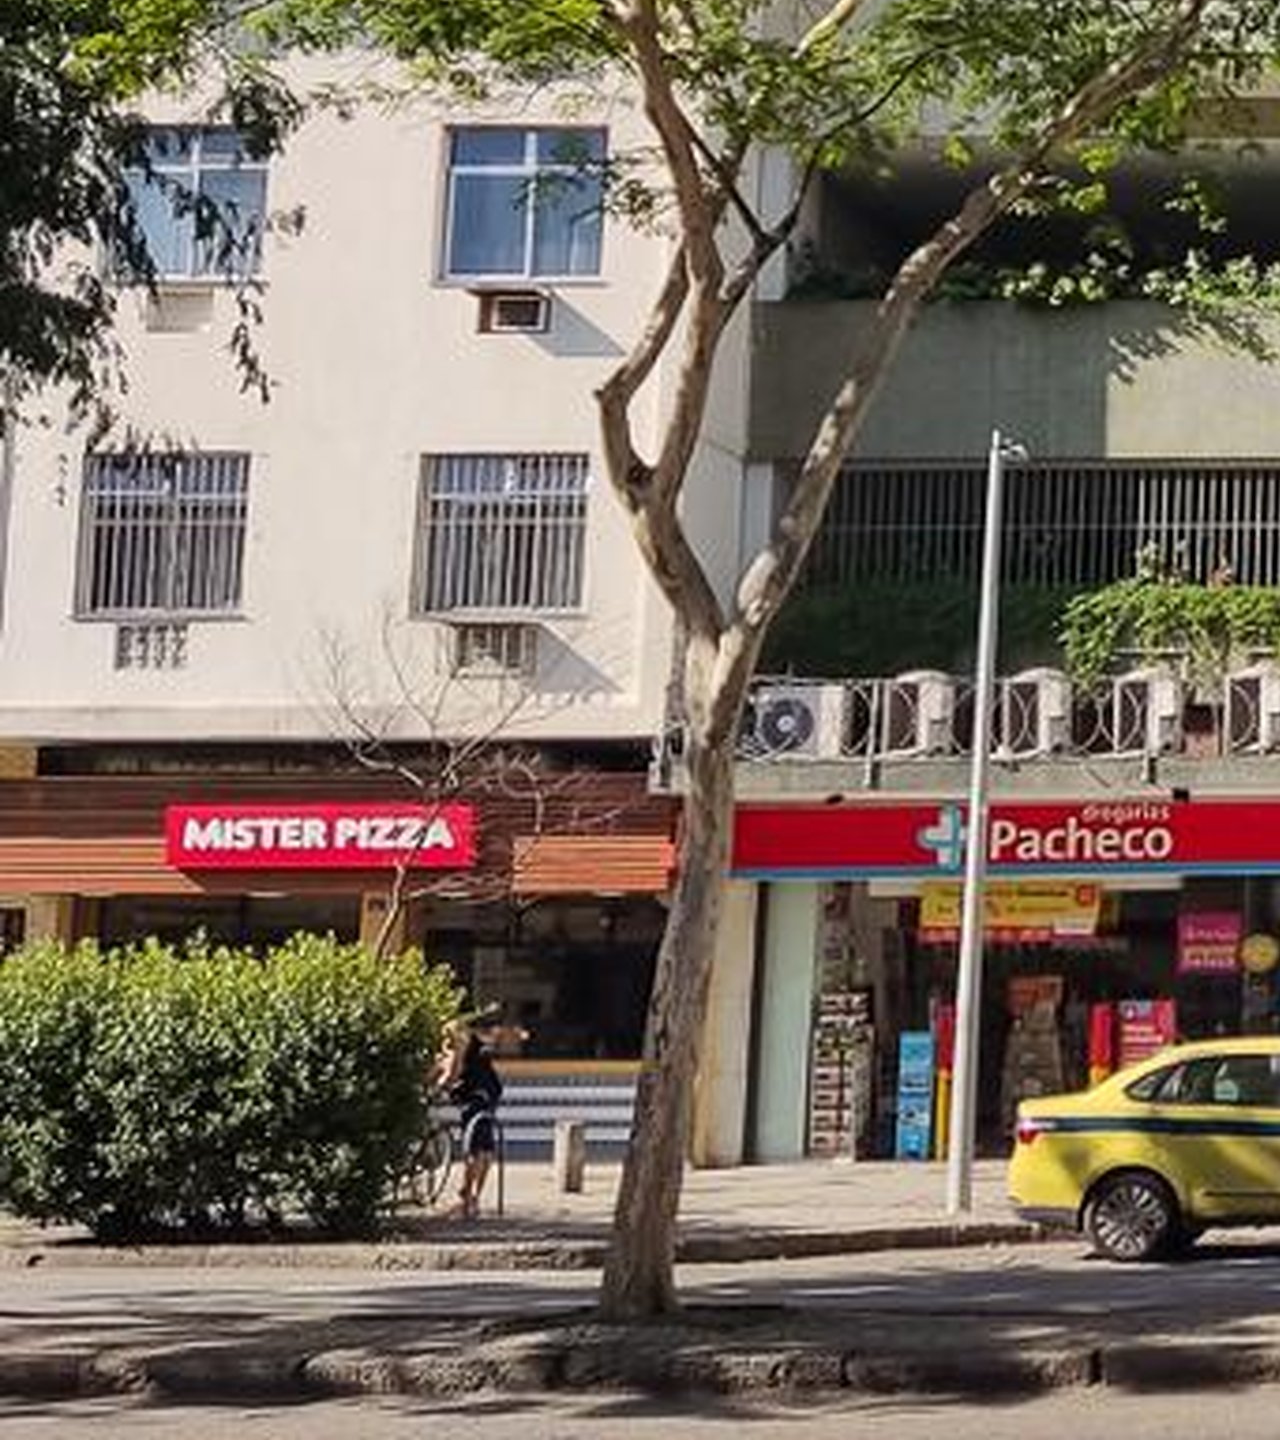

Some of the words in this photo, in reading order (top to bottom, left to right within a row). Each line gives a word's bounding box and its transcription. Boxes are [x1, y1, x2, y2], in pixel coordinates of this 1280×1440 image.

[1082, 804, 1172, 824] drogarias
[182, 817, 328, 850] MISTER
[334, 817, 455, 850] PIZZA
[989, 816, 1174, 860] Pacheco
